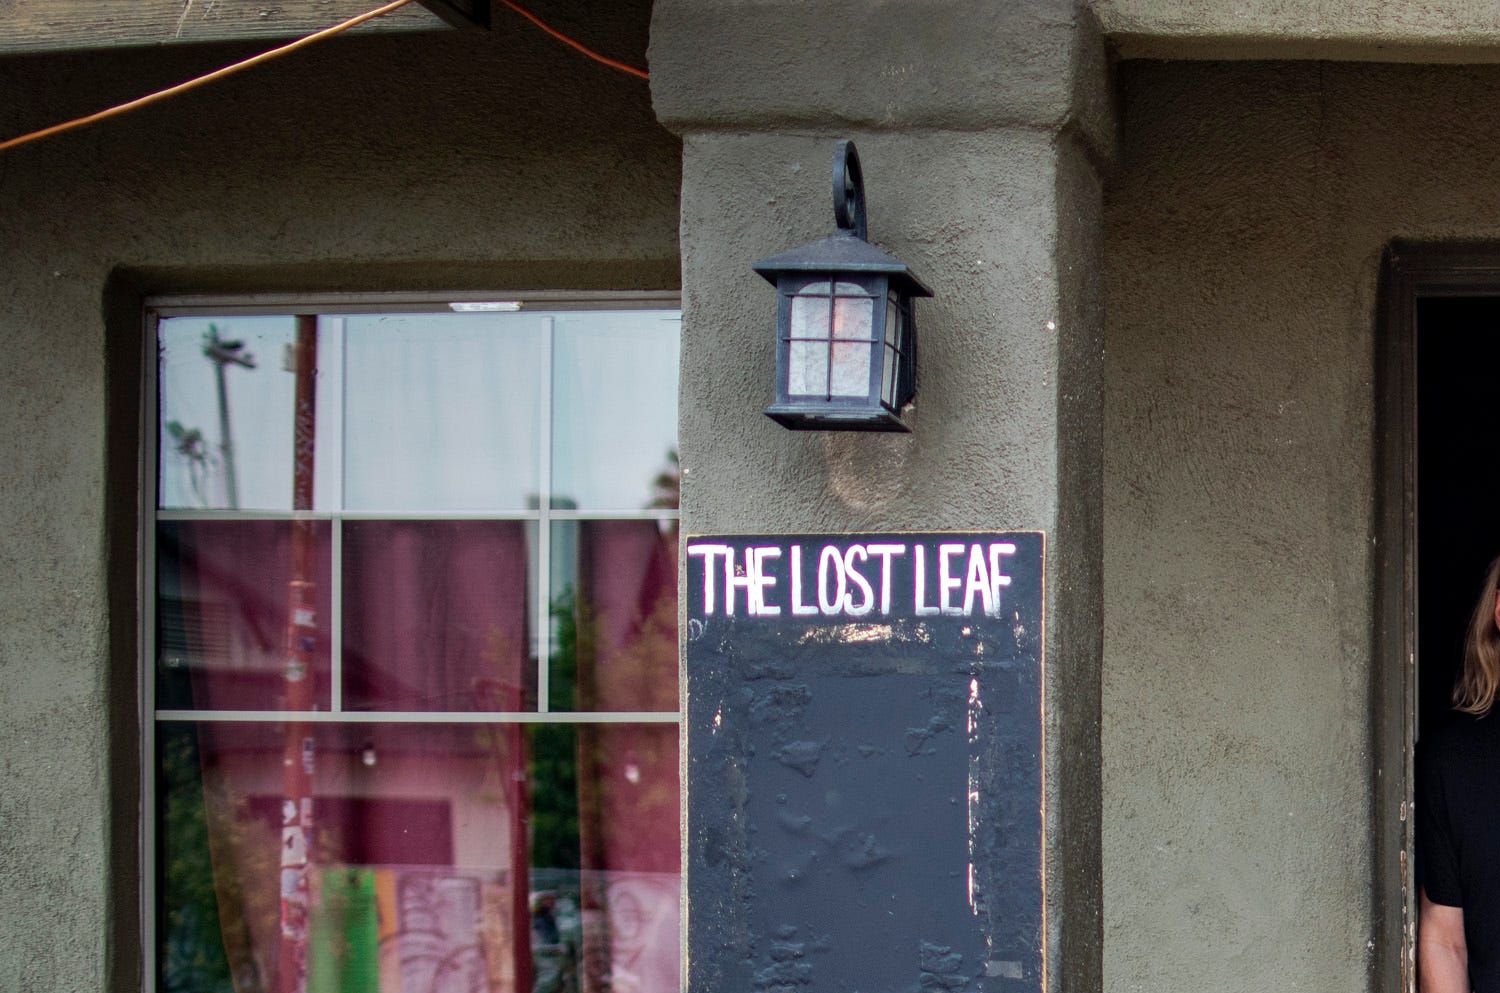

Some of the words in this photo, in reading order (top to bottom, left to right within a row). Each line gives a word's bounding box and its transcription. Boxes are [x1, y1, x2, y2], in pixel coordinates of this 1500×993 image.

[687, 543, 781, 616] THE
[791, 544, 905, 617] LOST
[914, 543, 1016, 618] LEAF
